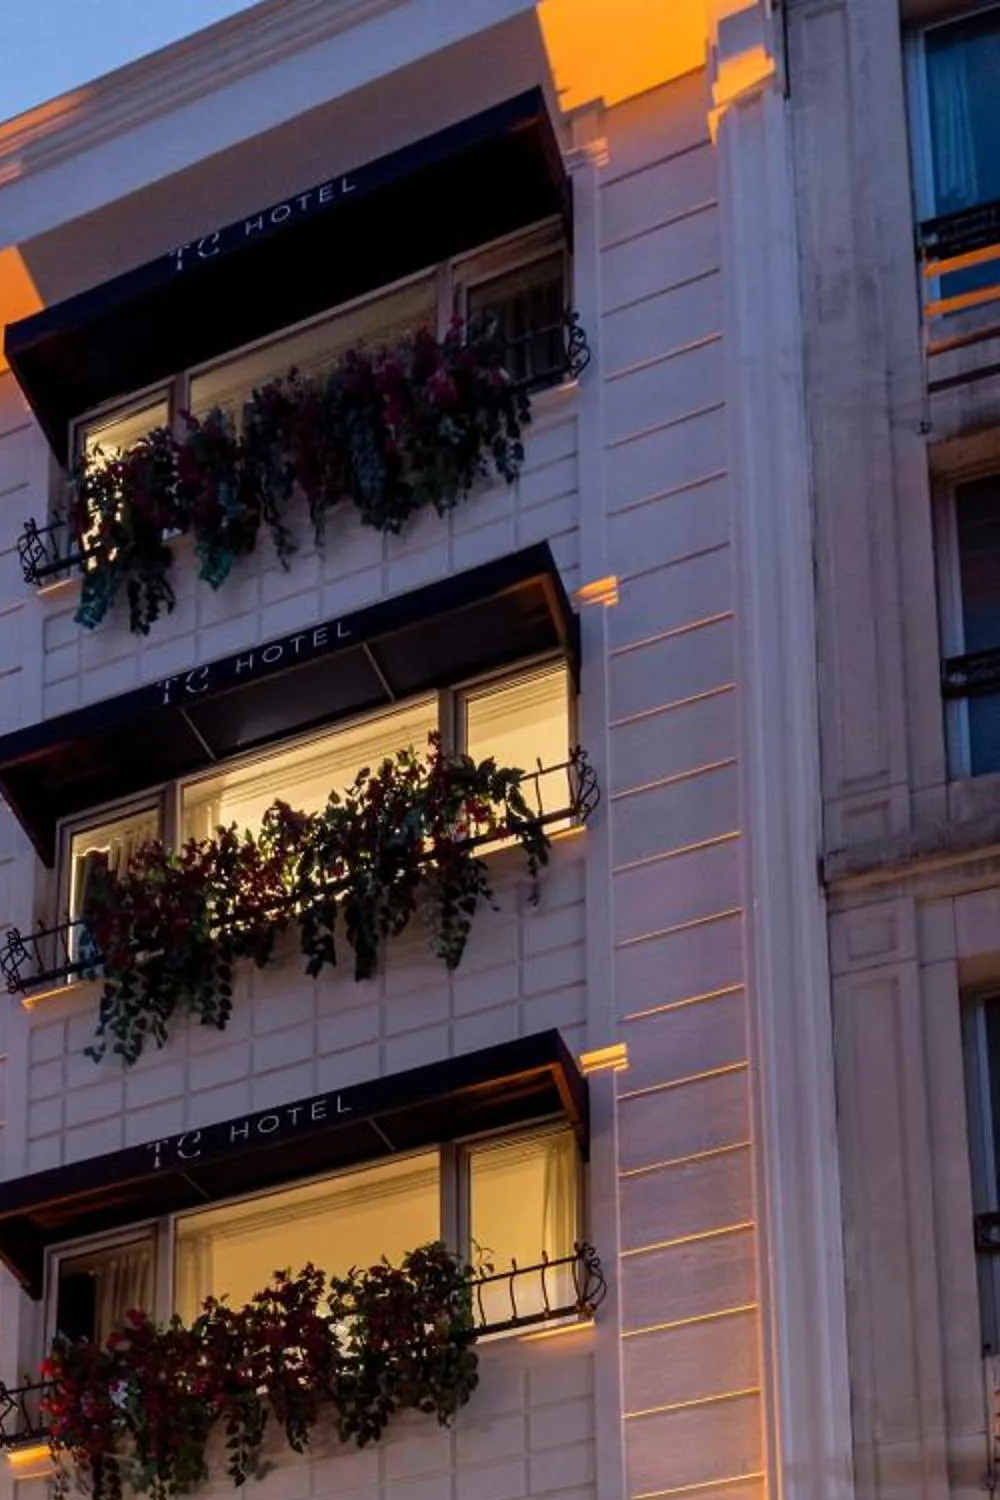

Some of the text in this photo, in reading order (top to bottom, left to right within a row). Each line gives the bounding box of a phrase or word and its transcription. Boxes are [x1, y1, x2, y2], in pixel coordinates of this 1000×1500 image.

[244, 177, 357, 235] HOTEL
[235, 622, 351, 673] HOTEL
[229, 1095, 352, 1143] HOTEL
